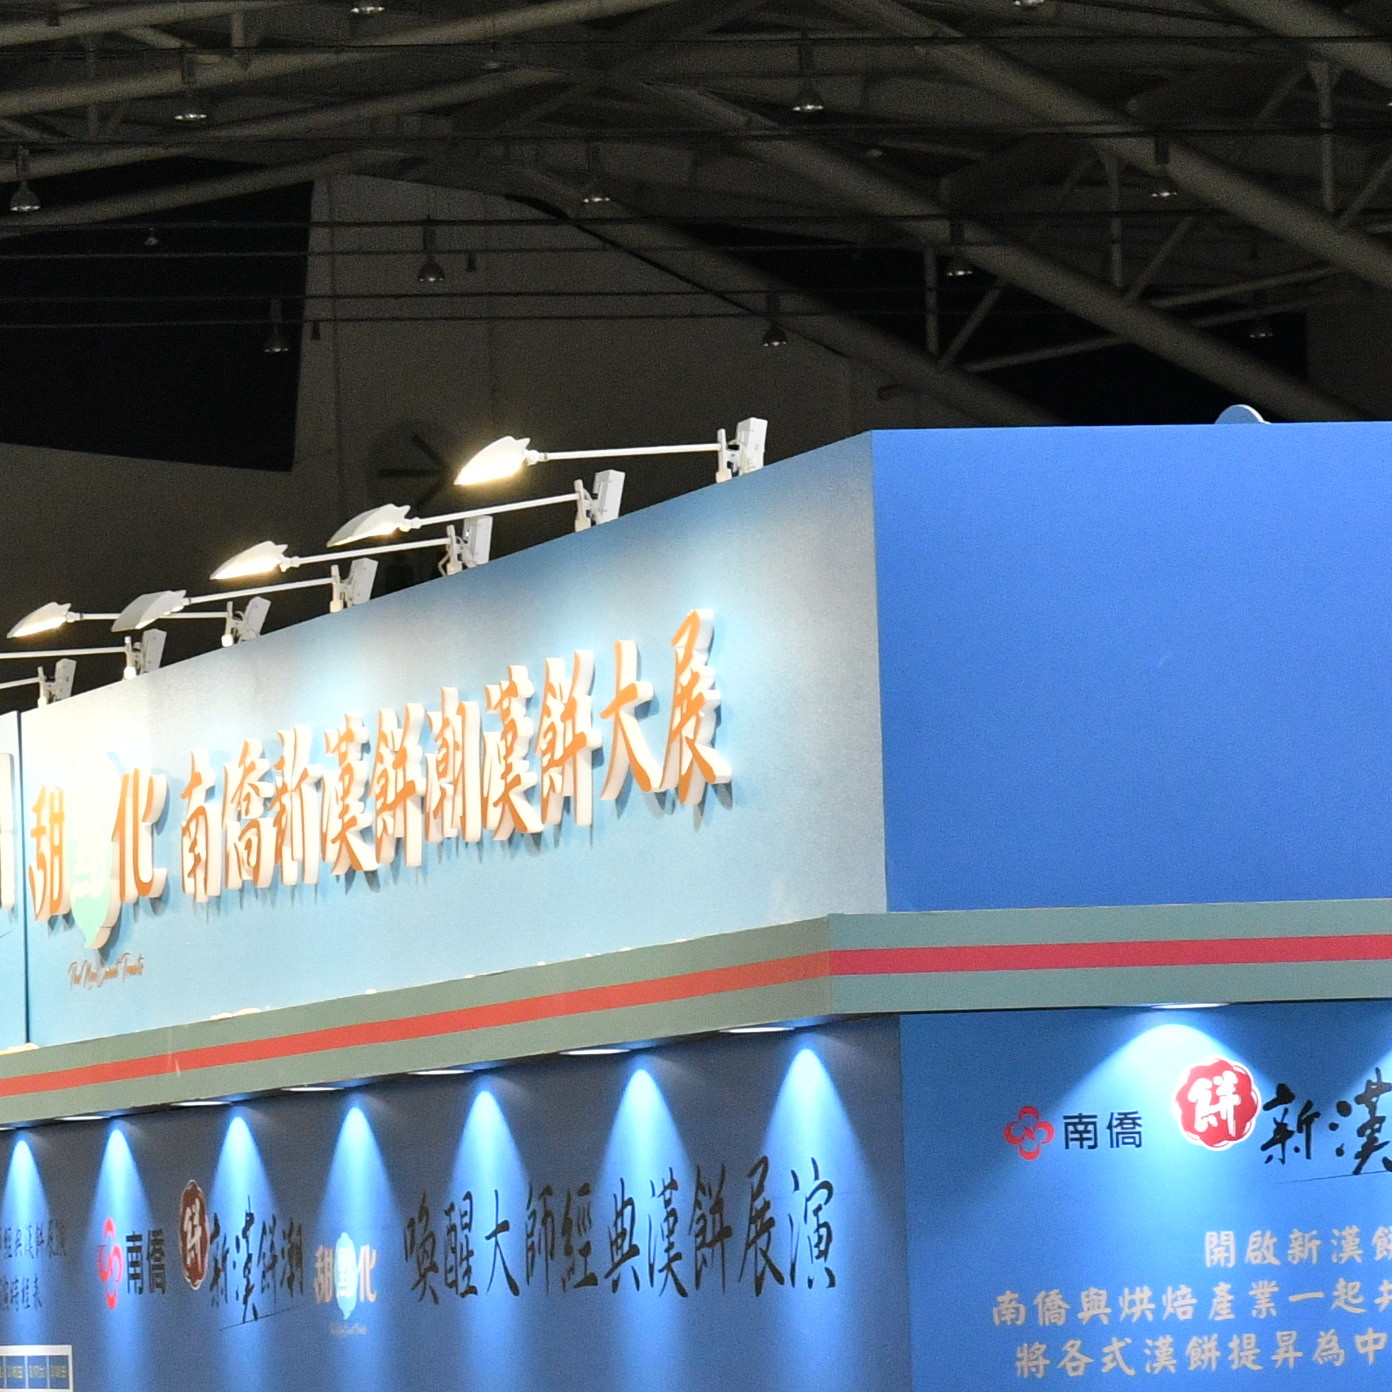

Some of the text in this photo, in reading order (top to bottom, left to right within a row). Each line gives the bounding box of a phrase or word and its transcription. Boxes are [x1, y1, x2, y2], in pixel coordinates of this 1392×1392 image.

[29, 767, 162, 922] 甜化
[1062, 1111, 1143, 1151] 南僑
[1187, 1069, 1242, 1137] 餅
